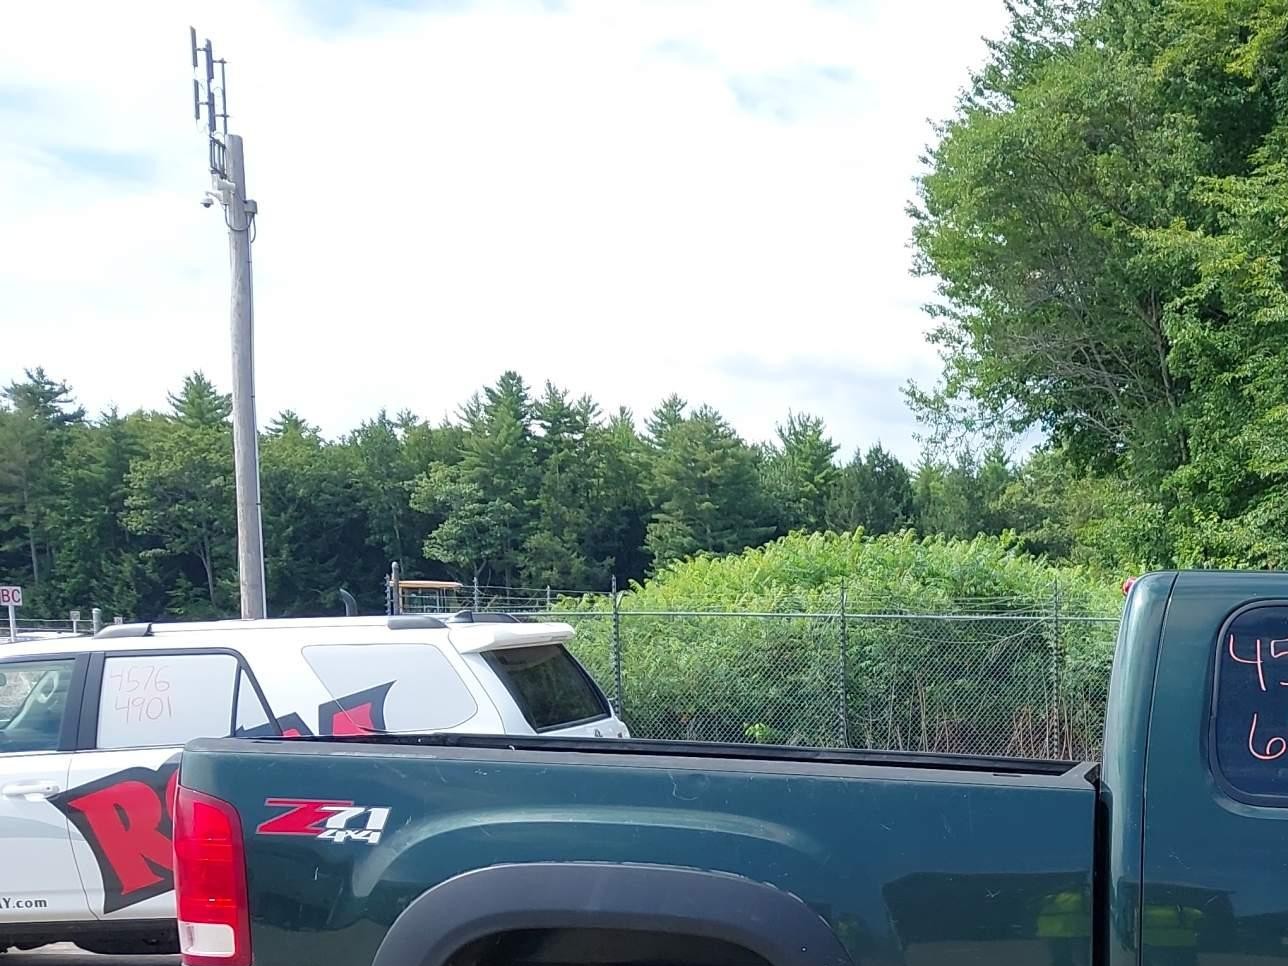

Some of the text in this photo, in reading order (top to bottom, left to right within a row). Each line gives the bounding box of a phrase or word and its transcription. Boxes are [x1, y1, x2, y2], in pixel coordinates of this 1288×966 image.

[110, 664, 170, 693] 4576
[114, 695, 173, 725] 4901
[255, 797, 393, 836] Z71
